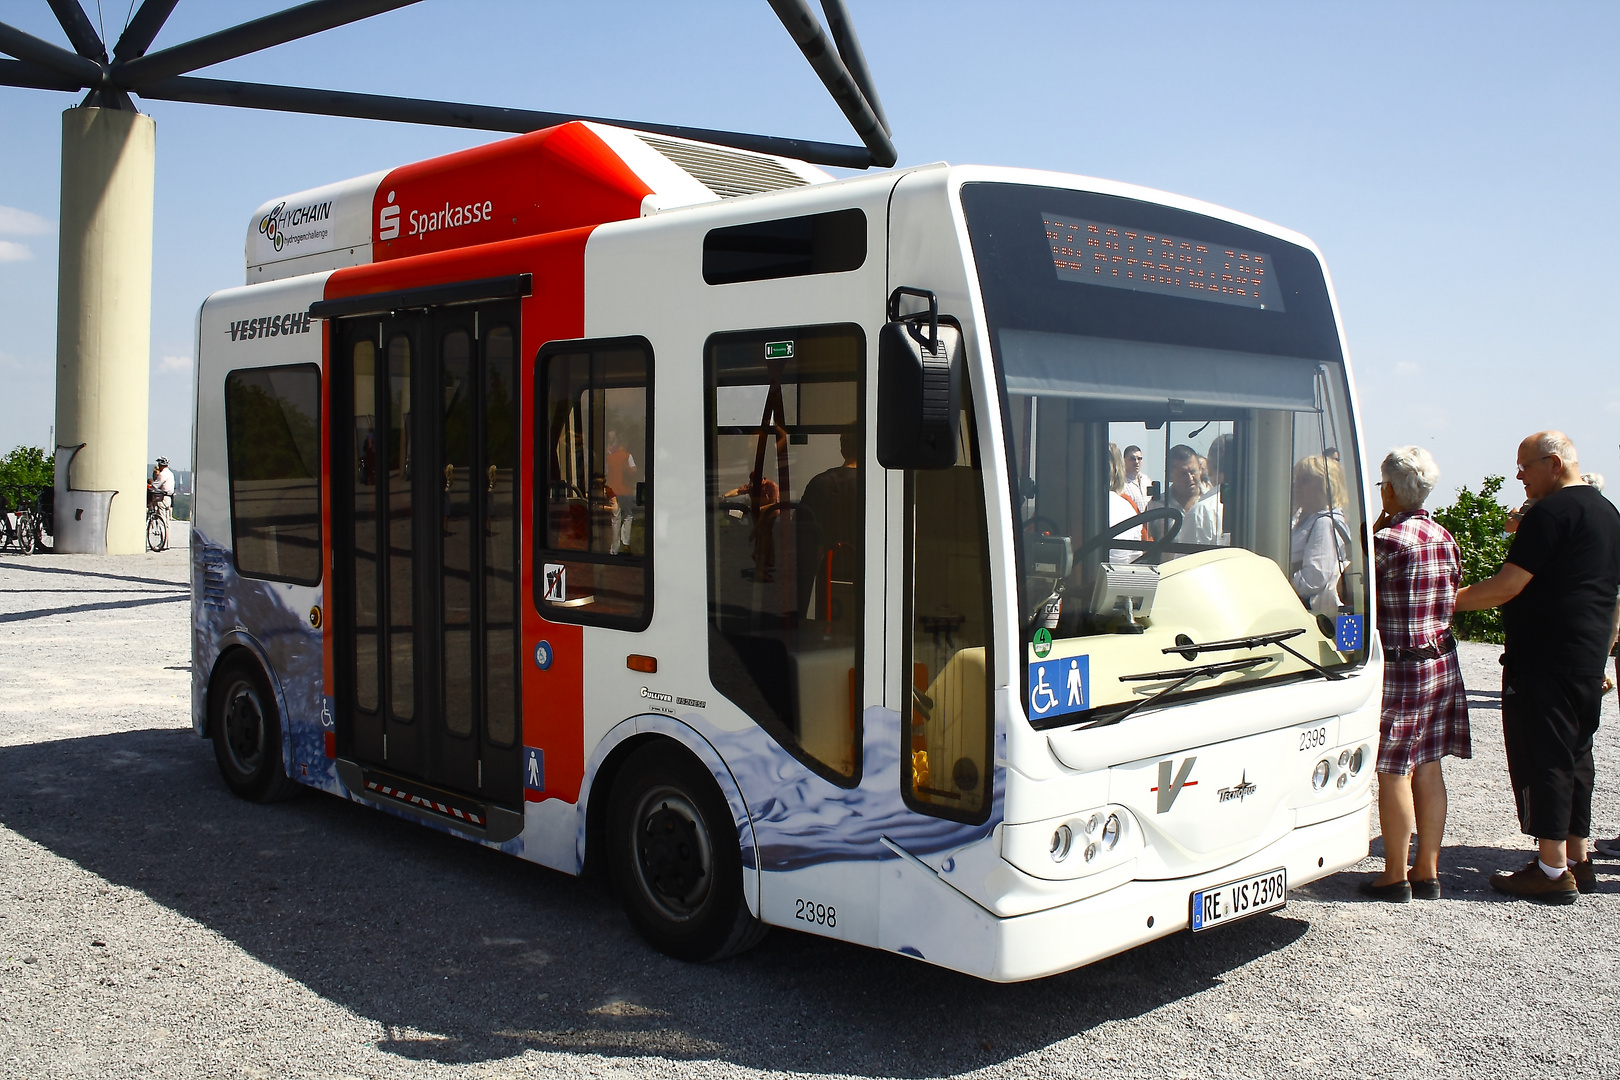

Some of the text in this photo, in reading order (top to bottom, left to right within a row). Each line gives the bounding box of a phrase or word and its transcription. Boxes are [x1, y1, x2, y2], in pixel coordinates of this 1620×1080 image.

[278, 201, 333, 230] HYCHAIN
[408, 200, 493, 240] Sparkasse
[283, 229, 329, 247] hydrogenchallenge
[230, 312, 310, 342] VESTISCHE
[1299, 727, 1326, 751] 2398
[795, 898, 837, 928] 2398
[1204, 874, 1283, 922] RE VS 2398
